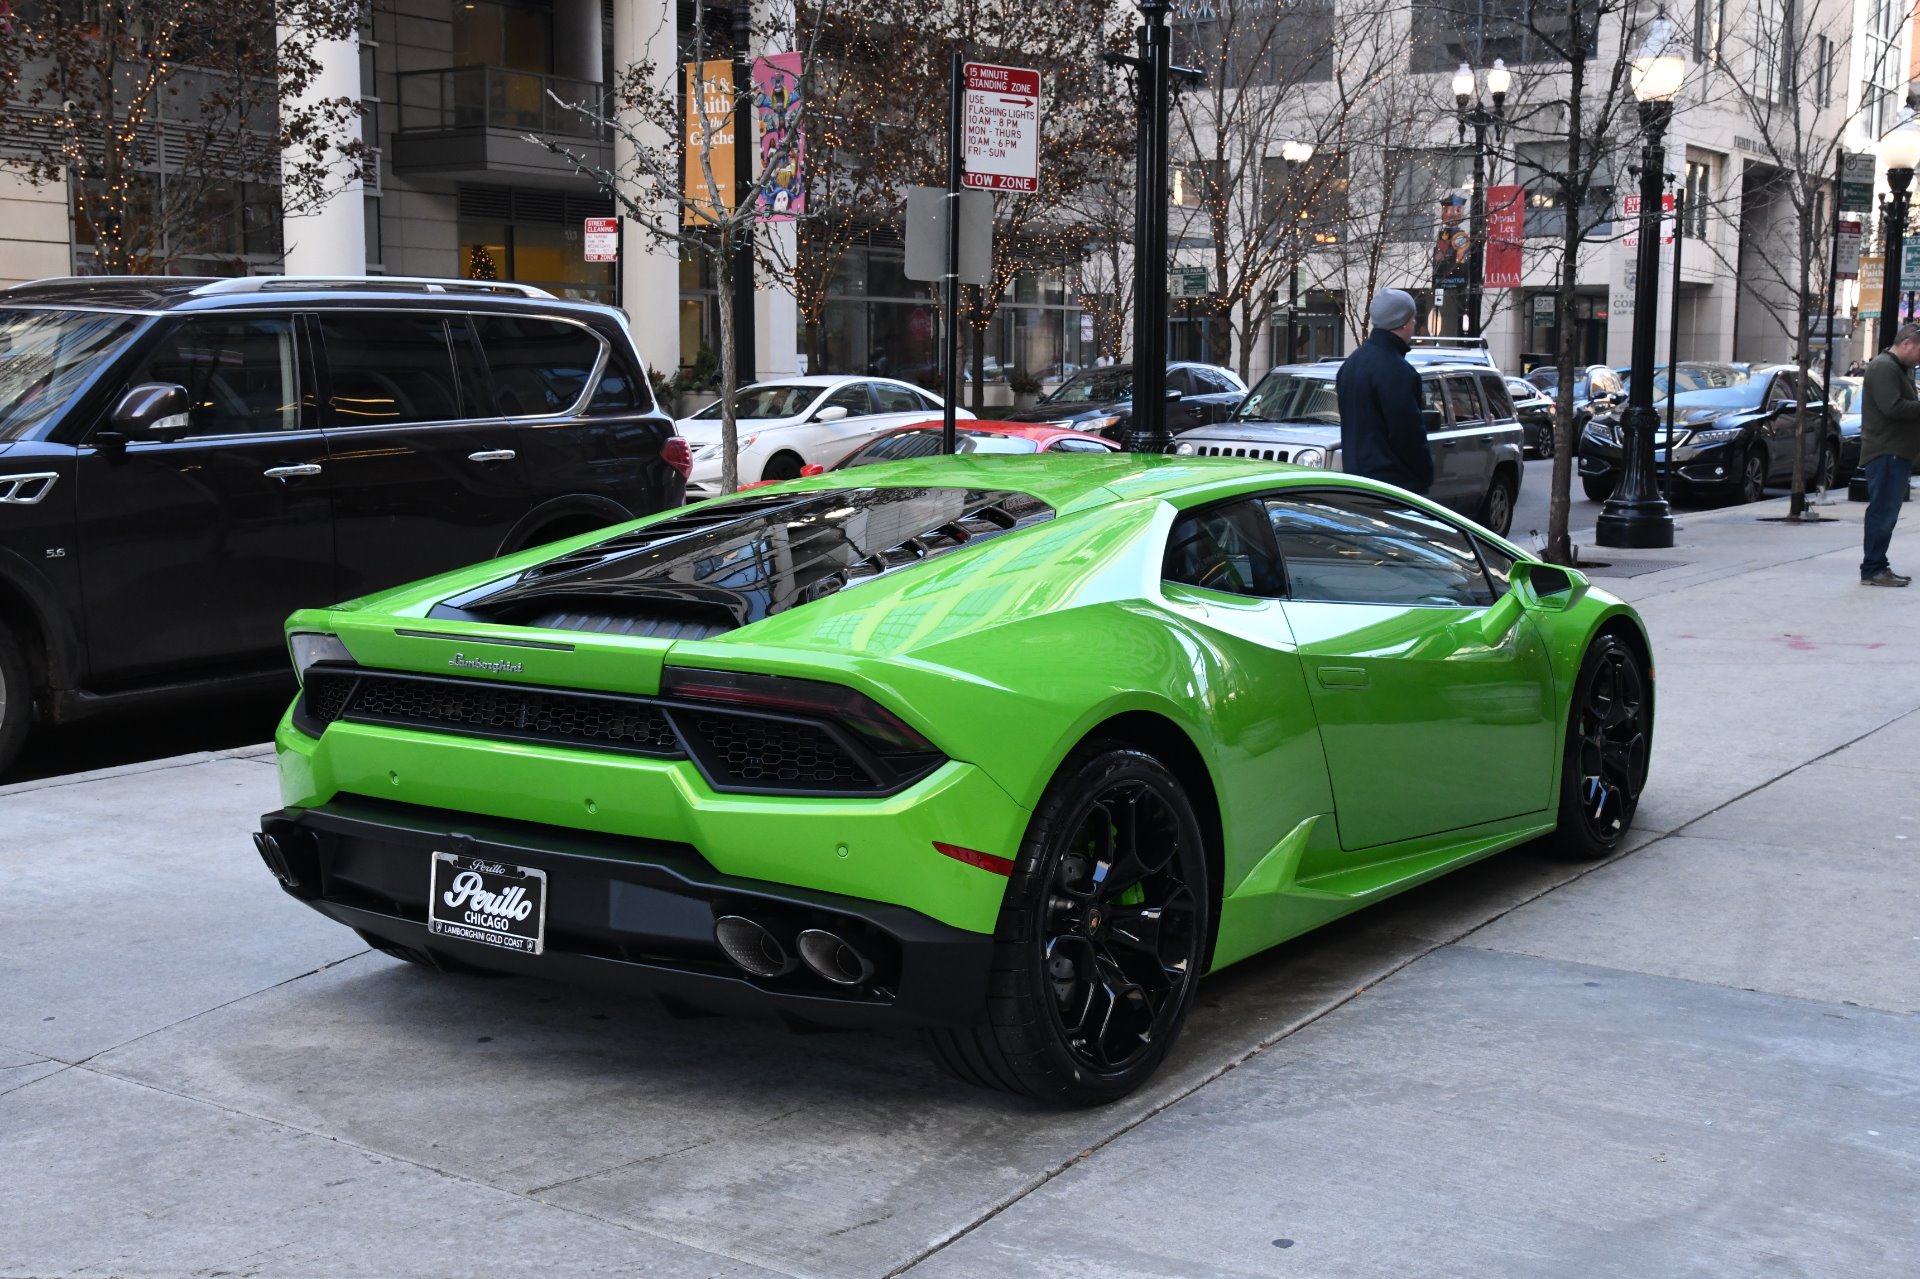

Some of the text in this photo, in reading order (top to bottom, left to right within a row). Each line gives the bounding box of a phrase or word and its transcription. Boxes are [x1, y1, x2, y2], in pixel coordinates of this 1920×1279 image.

[970, 67, 1009, 80] 15 MINUTE
[720, 77, 730, 93] &
[970, 79, 1031, 94] STANDING ZONE
[969, 94, 985, 104] USE
[969, 105, 1035, 120] FLASHING LIGHTS
[968, 115, 977, 125] 10
[979, 116, 991, 126] AM
[998, 118, 1004, 127] 8
[1006, 119, 1018, 128] PM
[690, 130, 735, 145] Cche
[968, 126, 986, 136] MON
[995, 128, 1021, 139] THURS
[968, 136, 977, 145] 10
[978, 137, 989, 146] AM
[998, 139, 1004, 147] 6
[1005, 140, 1017, 149] PM
[968, 146, 981, 156] FRI
[989, 147, 1005, 158] SUN
[968, 173, 1031, 190] TOW ZONE
[1484, 272, 1520, 284] LUMA
[46, 547, 66, 558] 5.6
[448, 652, 523, 673] Lamborghini
[469, 859, 506, 874] Perillo
[443, 871, 533, 921] Perillo
[464, 910, 509, 931] CHICAGO
[444, 925, 523, 948] LAMBORGHINI GOLD COAST
